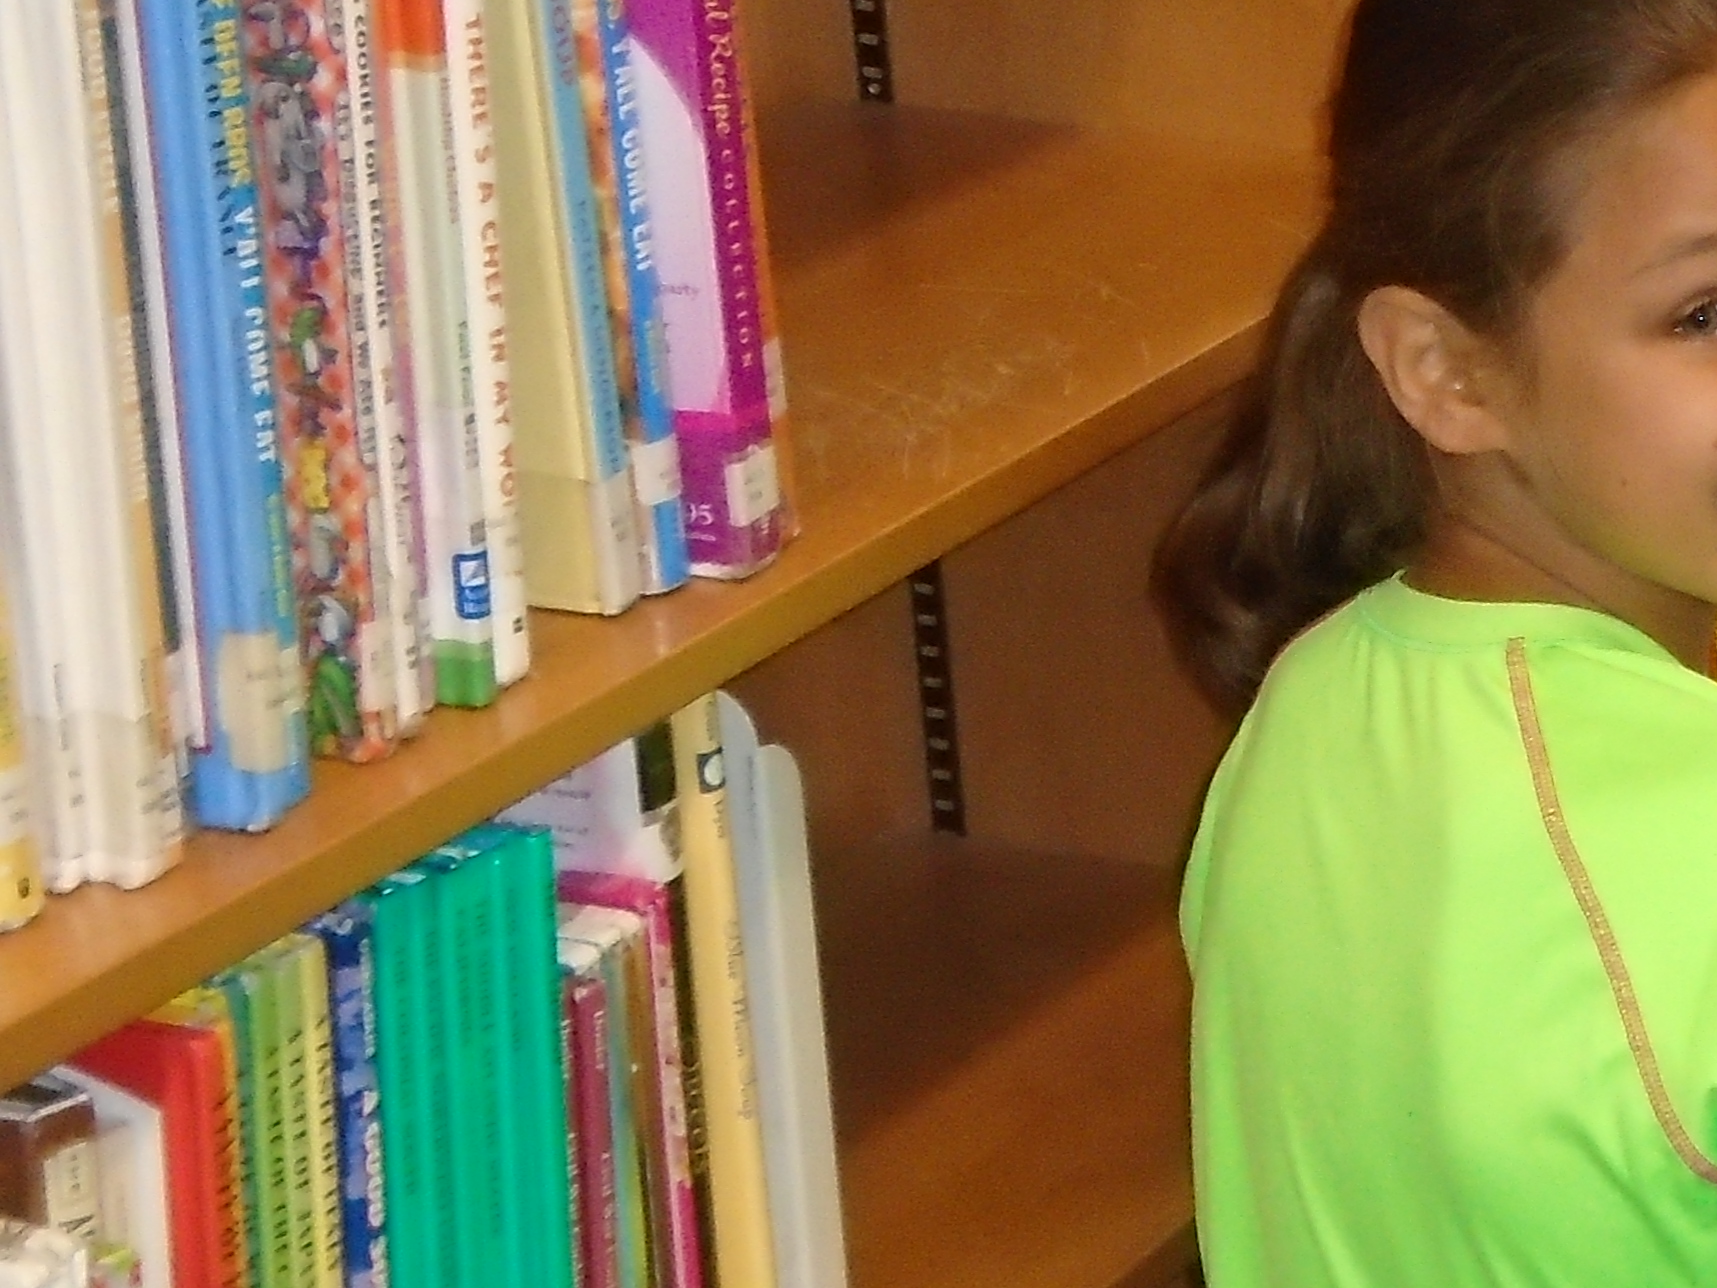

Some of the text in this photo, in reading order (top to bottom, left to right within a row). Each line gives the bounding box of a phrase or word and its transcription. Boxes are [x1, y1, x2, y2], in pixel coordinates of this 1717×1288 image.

[214, 19, 244, 98] DEEN
[354, 14, 374, 125] COOKIES
[464, 12, 495, 166] THERE'S
[707, 34, 735, 139] Recipe
[364, 140, 378, 186] FOR
[476, 180, 497, 204] A
[619, 130, 646, 215] COME
[369, 198, 388, 328] BEGINNERS
[482, 219, 504, 310] CHEF
[631, 224, 654, 273] EAT
[244, 307, 270, 399] COME
[490, 327, 508, 363] IN
[254, 410, 276, 464] EAT
[494, 380, 512, 428] MY
[266, 1069, 285, 1144] TASTE
[289, 1058, 310, 1141] TASTE
[316, 1043, 335, 1126] TASTE
[214, 1119, 239, 1212] TASTE
[271, 1157, 288, 1189] OF
[293, 1157, 312, 1190] OF
[322, 1141, 339, 1174] OF
[364, 1122, 385, 1227] GOOD
